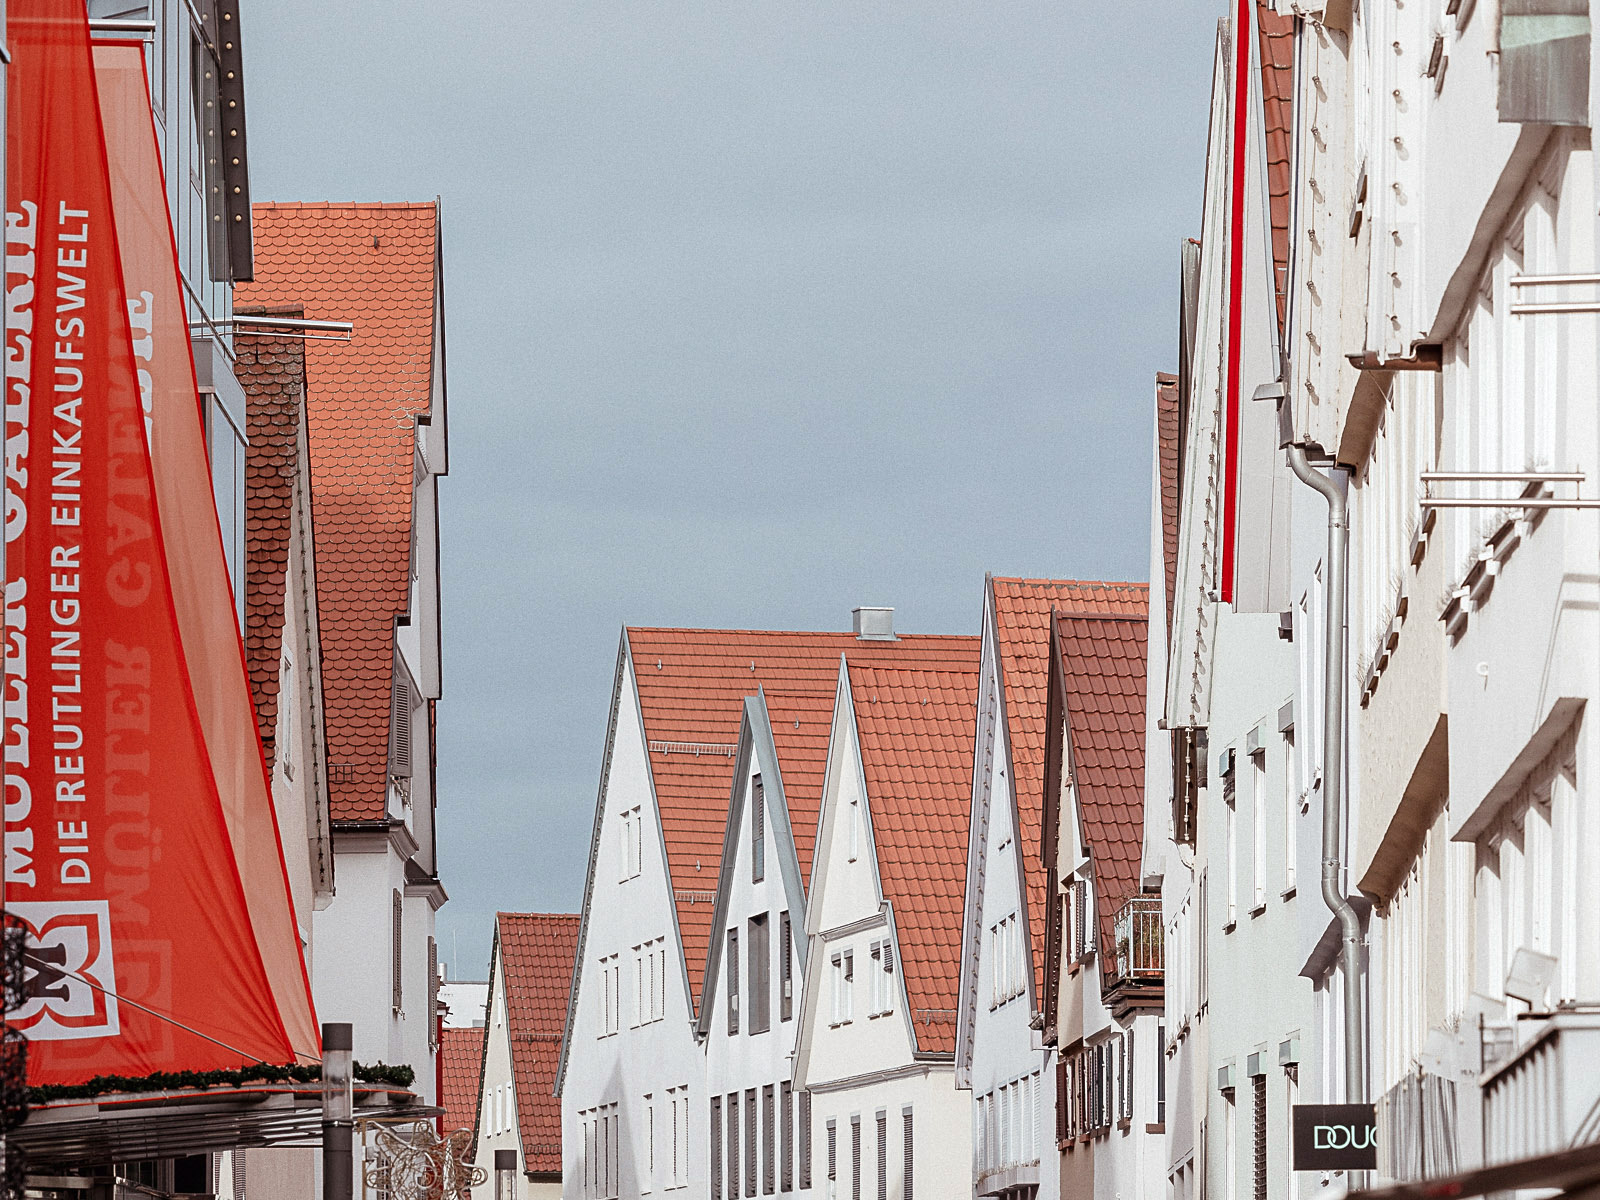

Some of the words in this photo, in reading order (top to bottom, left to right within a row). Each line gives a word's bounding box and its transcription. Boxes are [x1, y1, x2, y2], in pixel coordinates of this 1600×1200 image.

[51, 200, 90, 526] EINKAUFSWELT
[50, 544, 86, 802] REUTLINGER
[57, 820, 92, 884] DIE
